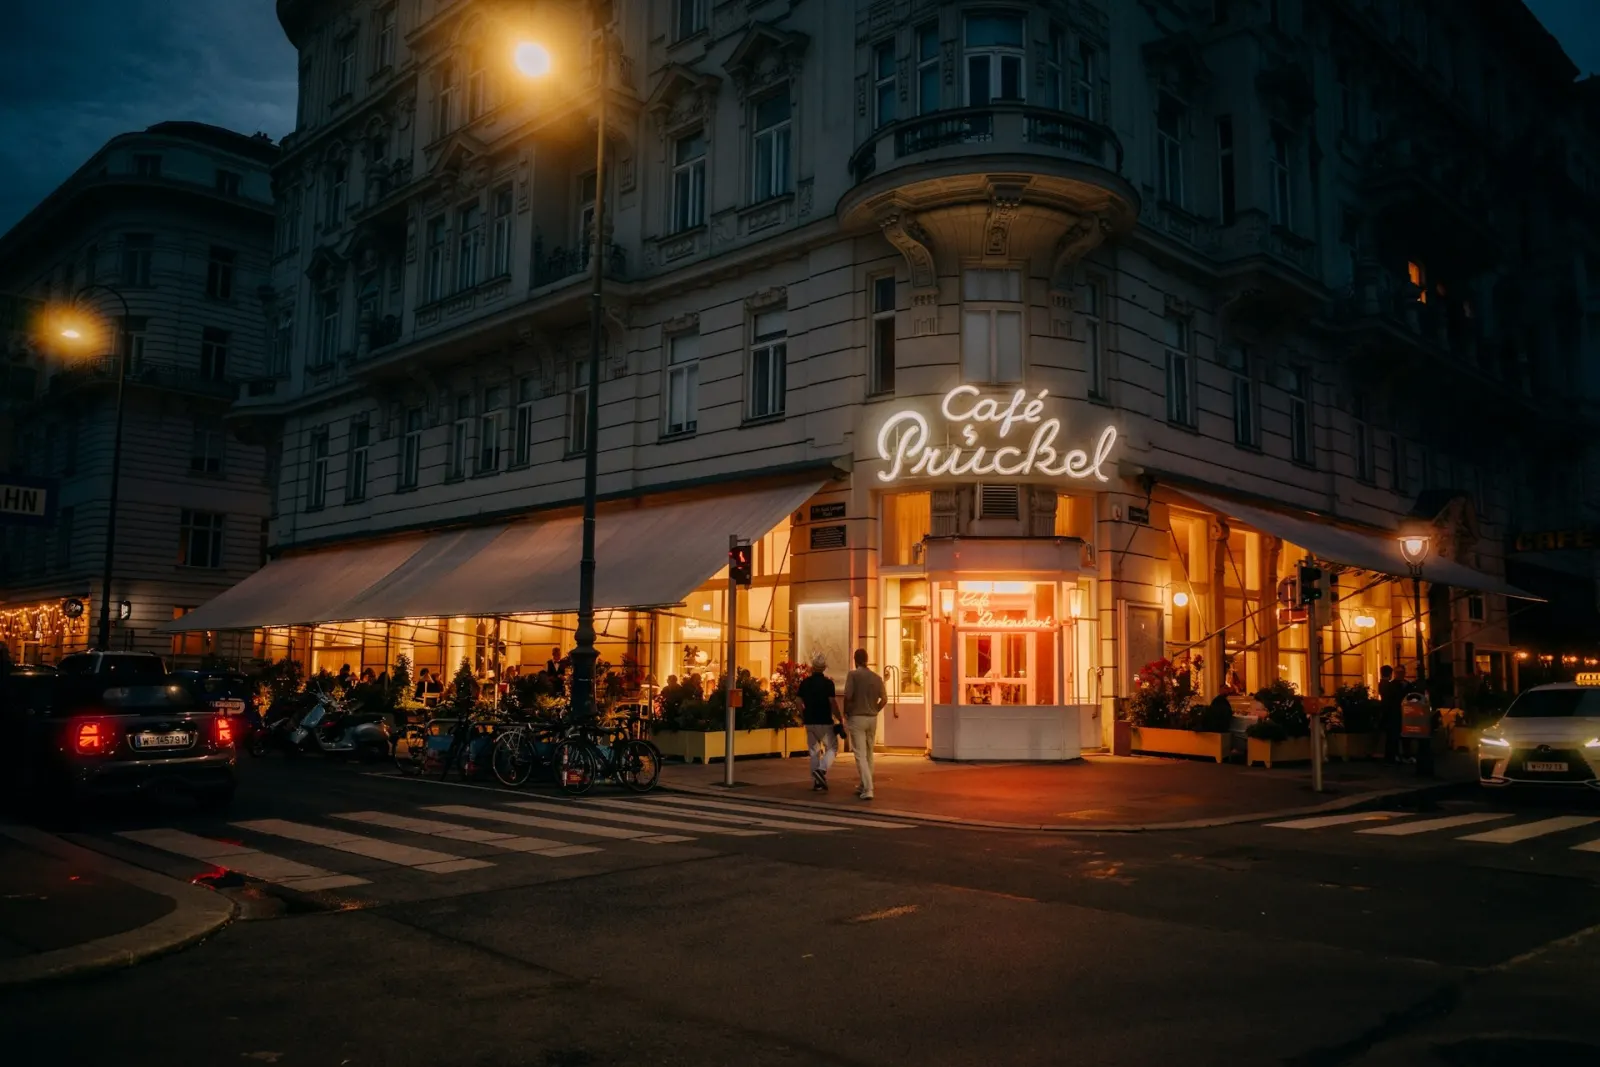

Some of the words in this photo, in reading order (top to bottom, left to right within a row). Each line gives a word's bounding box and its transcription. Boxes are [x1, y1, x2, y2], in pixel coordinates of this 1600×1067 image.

[942, 385, 1049, 438] Café
[877, 410, 1118, 482] Prückel
[0, 487, 37, 512] HN
[977, 611, 1051, 628] Restaurant
